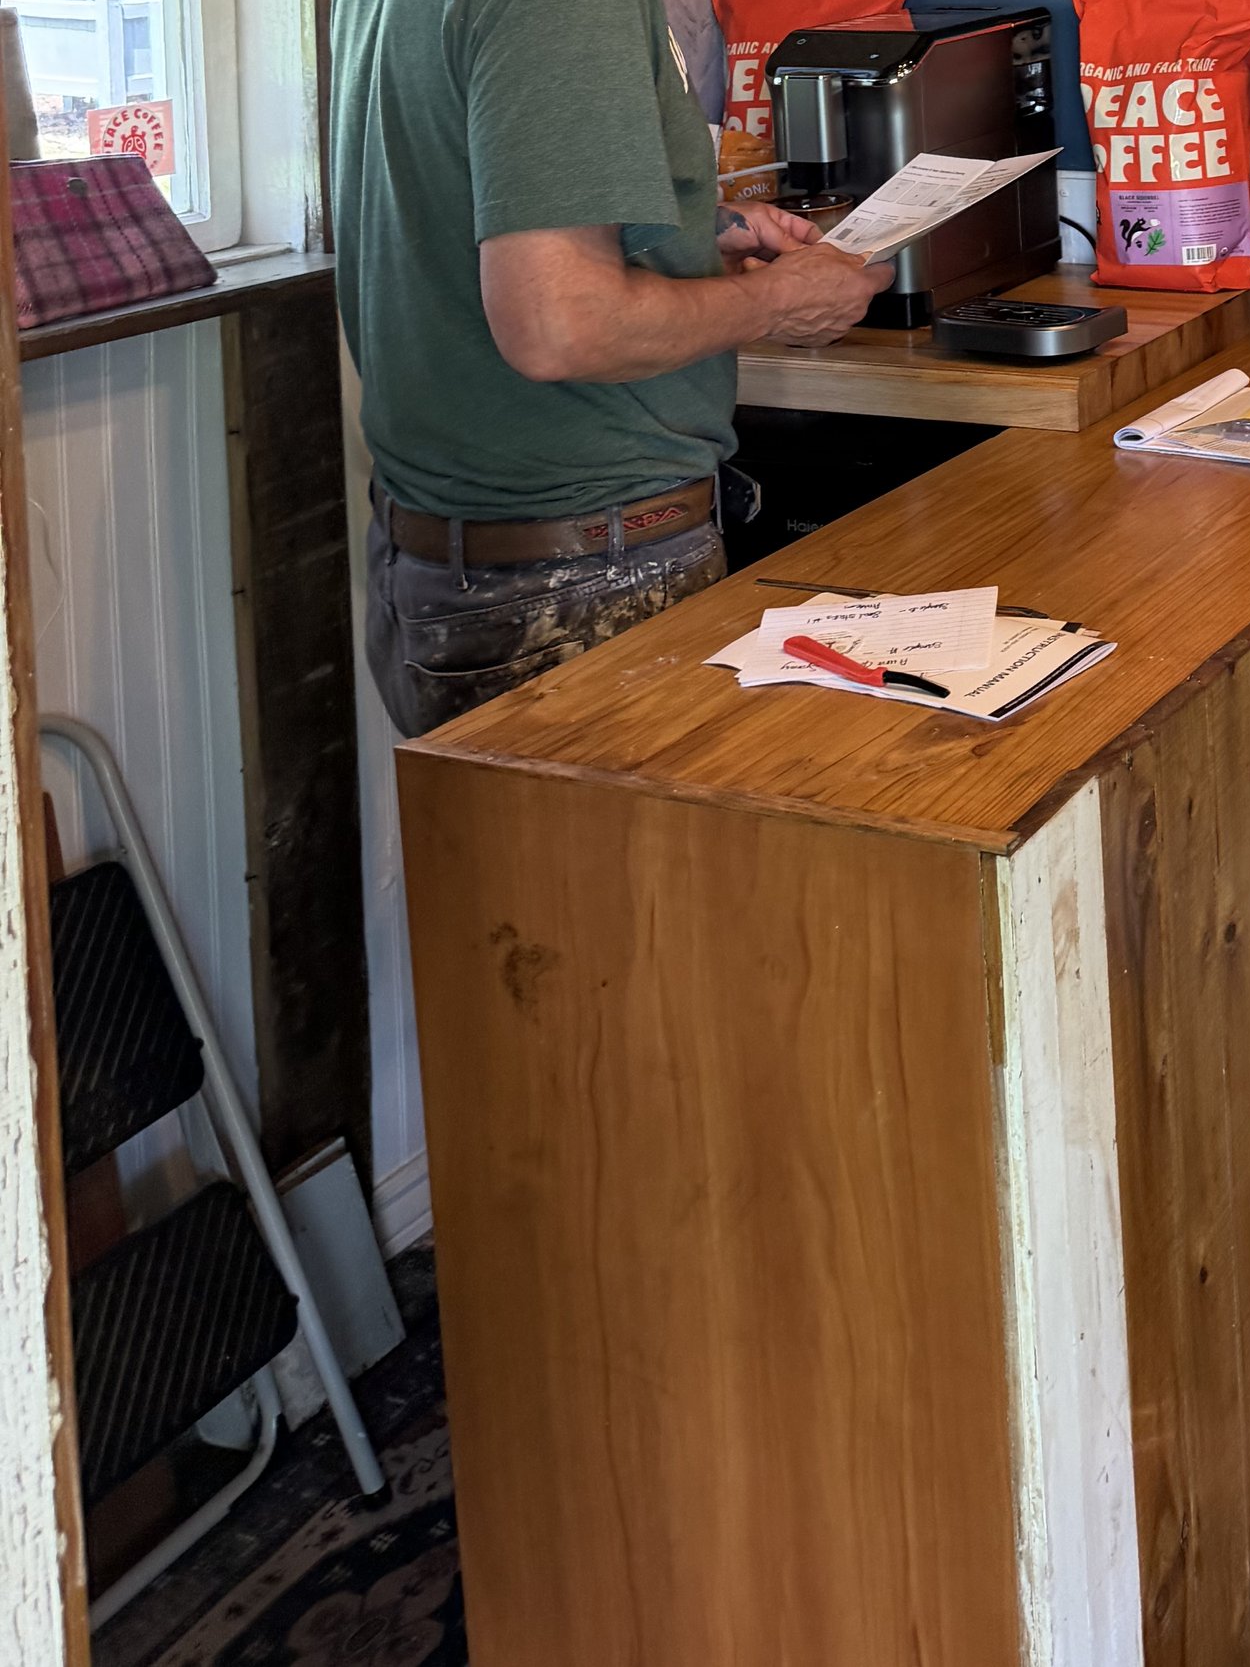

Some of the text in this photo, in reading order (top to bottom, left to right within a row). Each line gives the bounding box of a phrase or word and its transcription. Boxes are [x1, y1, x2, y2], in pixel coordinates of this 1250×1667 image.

[1080, 57, 1219, 81] RGANIC AND FAIR TRADE
[104, 110, 130, 154] EACE
[1093, 128, 1231, 183] OFFEE
[786, 518, 824, 533] Haie
[963, 669, 1010, 698] MANUAL
